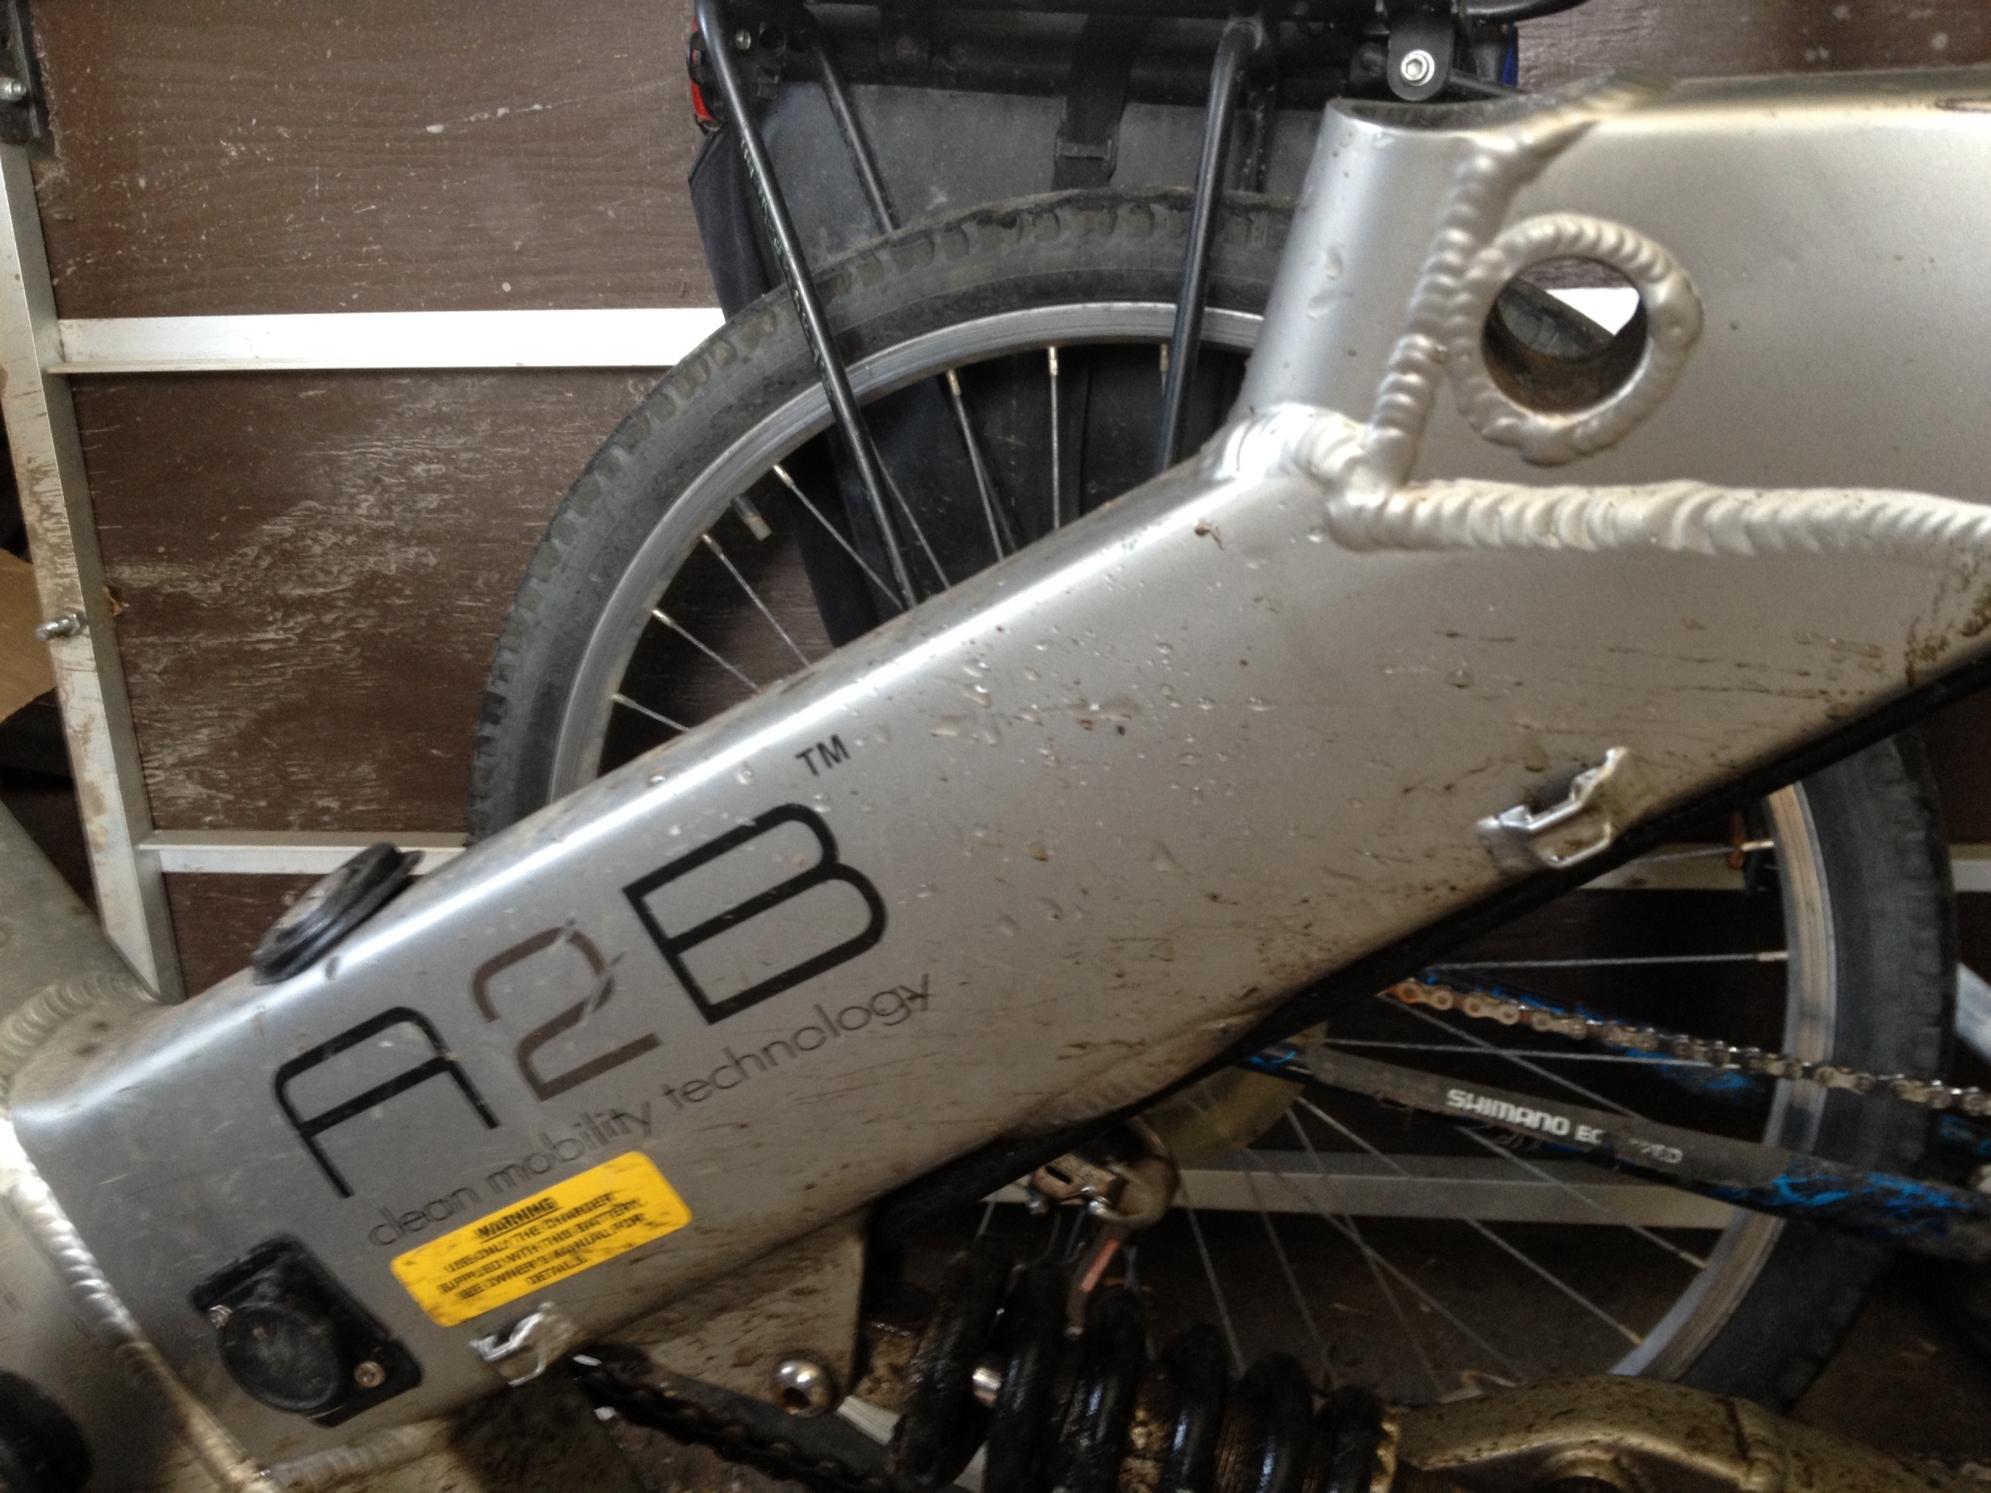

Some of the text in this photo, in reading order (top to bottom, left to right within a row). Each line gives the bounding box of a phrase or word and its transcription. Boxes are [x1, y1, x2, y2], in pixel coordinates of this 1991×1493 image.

[795, 734, 851, 776] TM
[273, 803, 888, 1198] A2B
[367, 973, 930, 1246] clean mobility technology
[1446, 1088, 1570, 1137] SHIMANO
[476, 1197, 558, 1239] WARNING
[510, 1226, 540, 1246] THE
[542, 1192, 614, 1229] CHARGER
[504, 1243, 539, 1263] WITH
[540, 1228, 574, 1249] THIS
